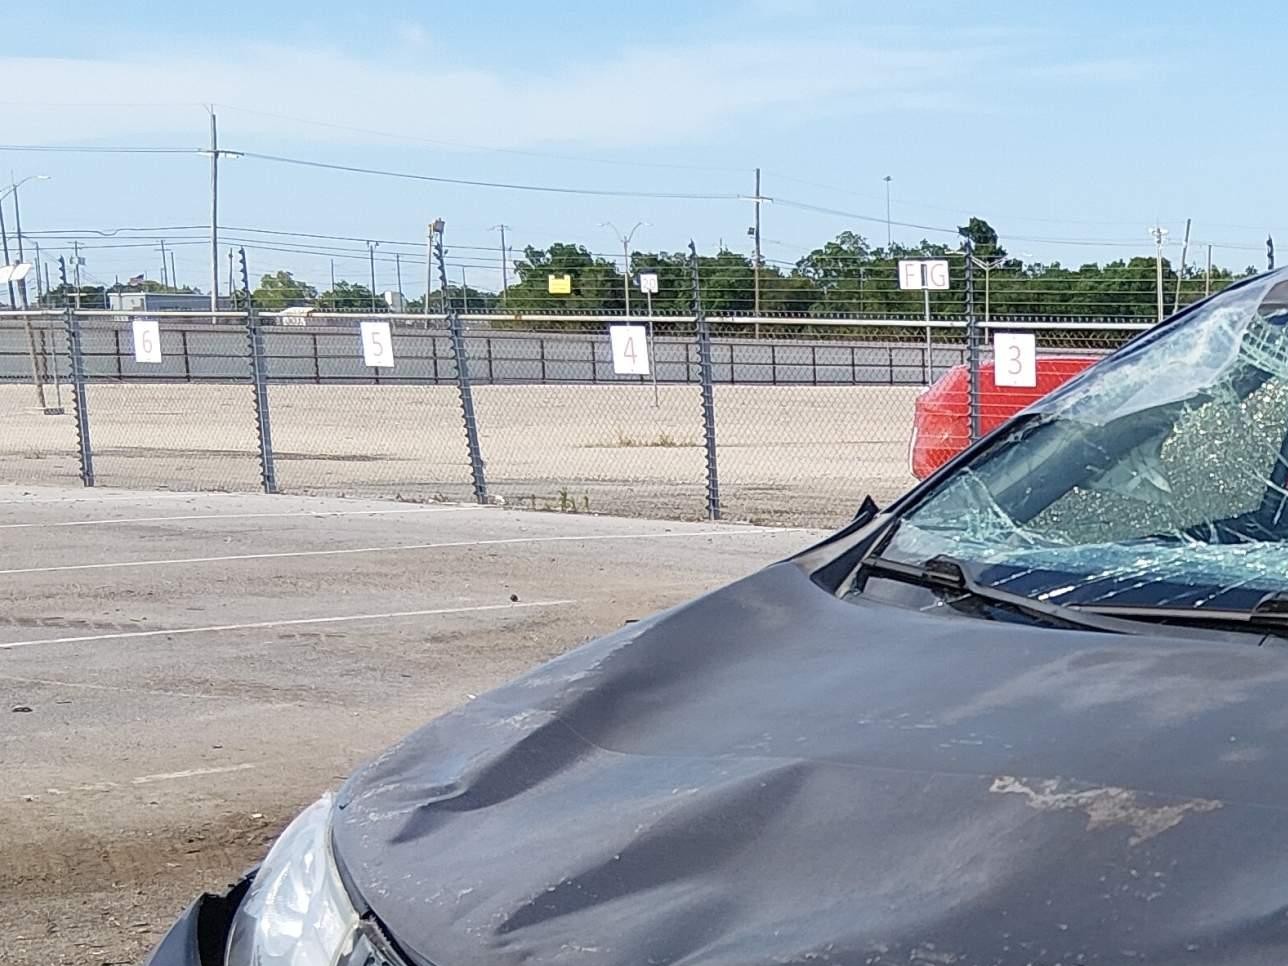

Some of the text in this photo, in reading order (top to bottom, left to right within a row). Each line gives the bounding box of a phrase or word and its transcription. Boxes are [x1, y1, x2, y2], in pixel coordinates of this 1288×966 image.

[142, 329, 153, 354] 6
[370, 331, 384, 357] 5
[623, 336, 638, 365] 4
[1007, 345, 1023, 375] 3
